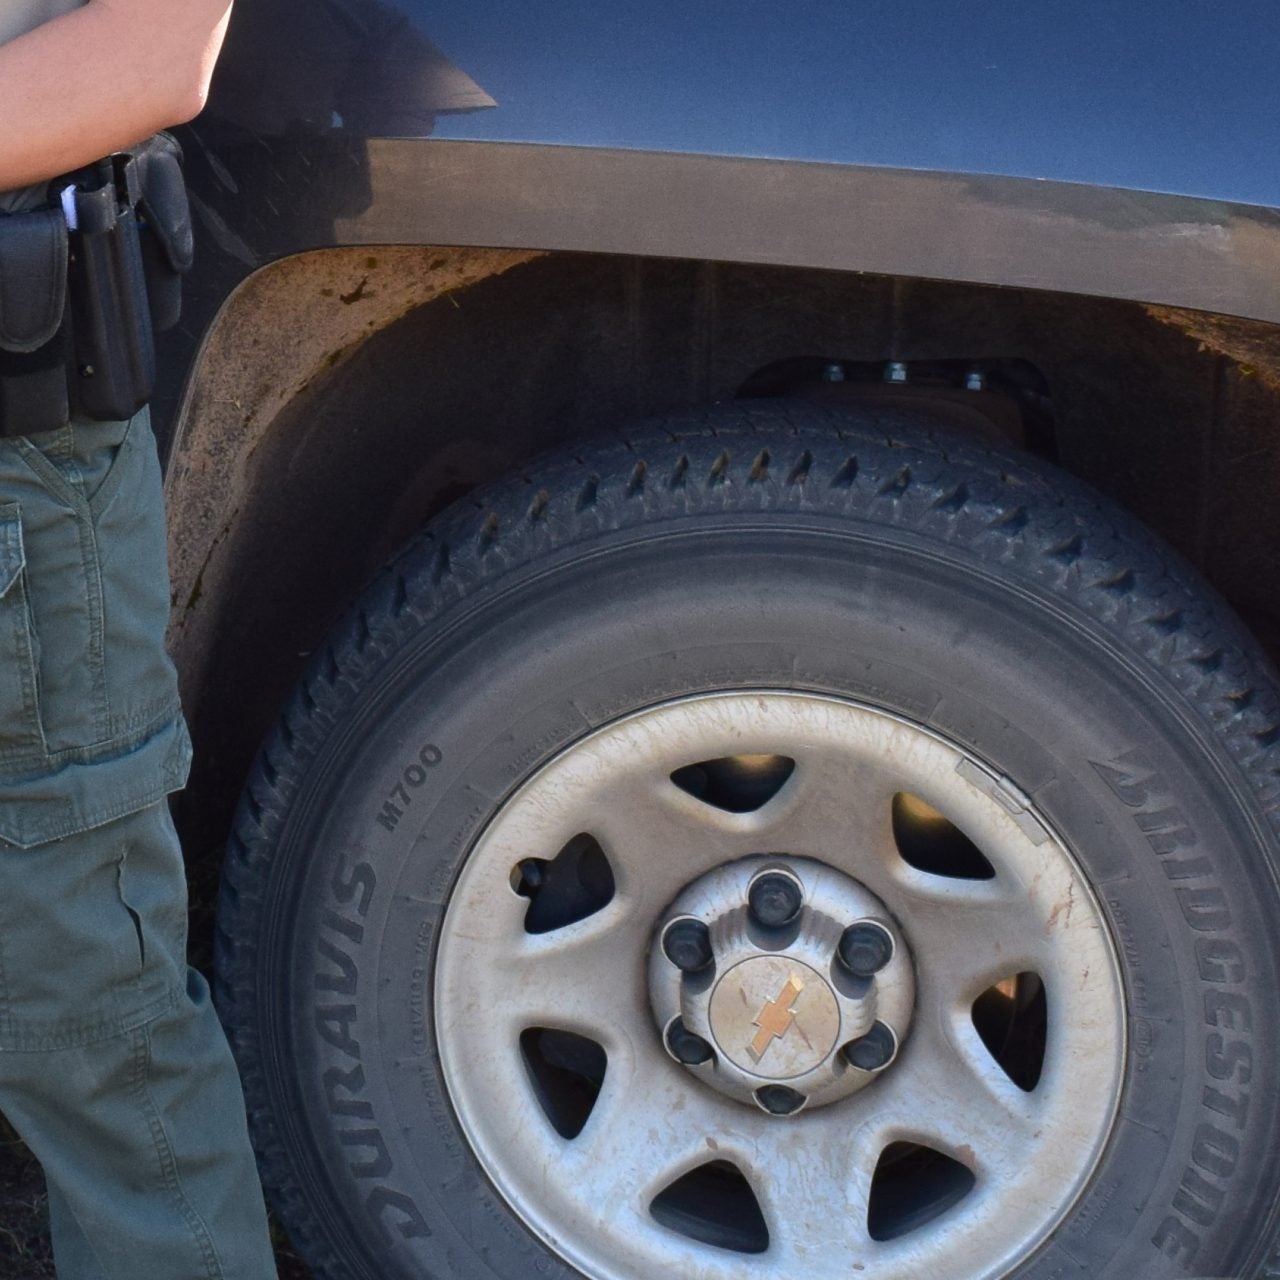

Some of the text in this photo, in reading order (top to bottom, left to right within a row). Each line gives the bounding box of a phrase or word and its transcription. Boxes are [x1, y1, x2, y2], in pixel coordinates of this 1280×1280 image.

[375, 743, 442, 832] M700
[314, 851, 433, 1244] DURAVIS
[1088, 750, 1253, 1272] BRIDGESTONE
